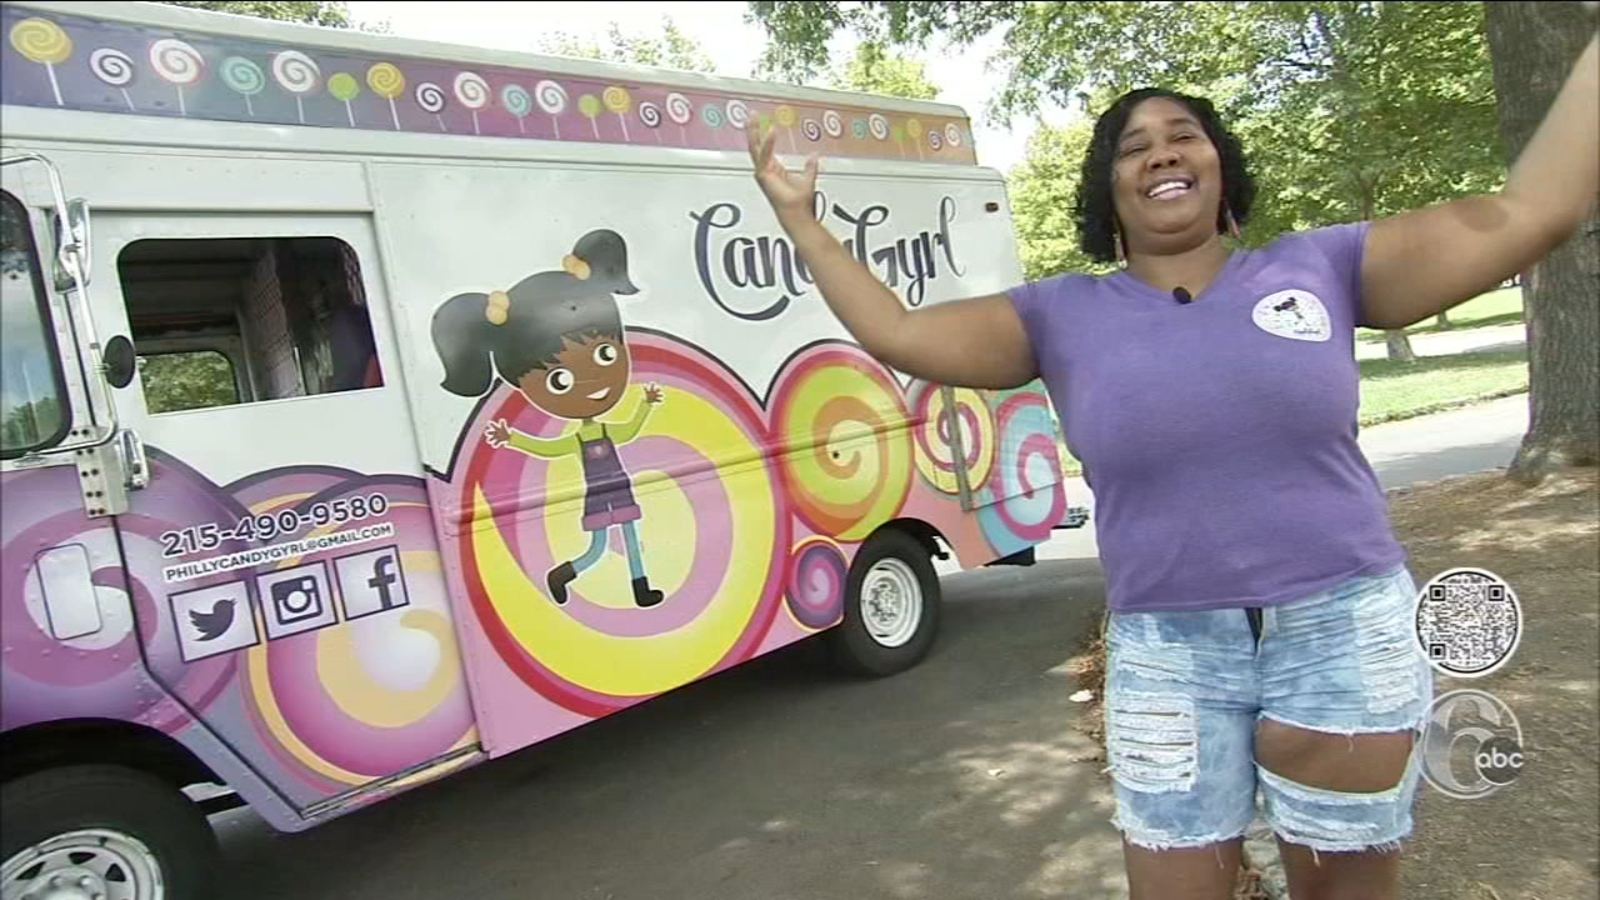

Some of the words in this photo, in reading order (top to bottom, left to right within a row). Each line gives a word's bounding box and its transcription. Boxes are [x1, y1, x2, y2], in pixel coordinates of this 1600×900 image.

[689, 191, 966, 321] CanGyrl
[162, 494, 387, 556] 215-490-9580
[165, 524, 392, 581] PHILLYCANDYGYRL@GMAIL.COM
